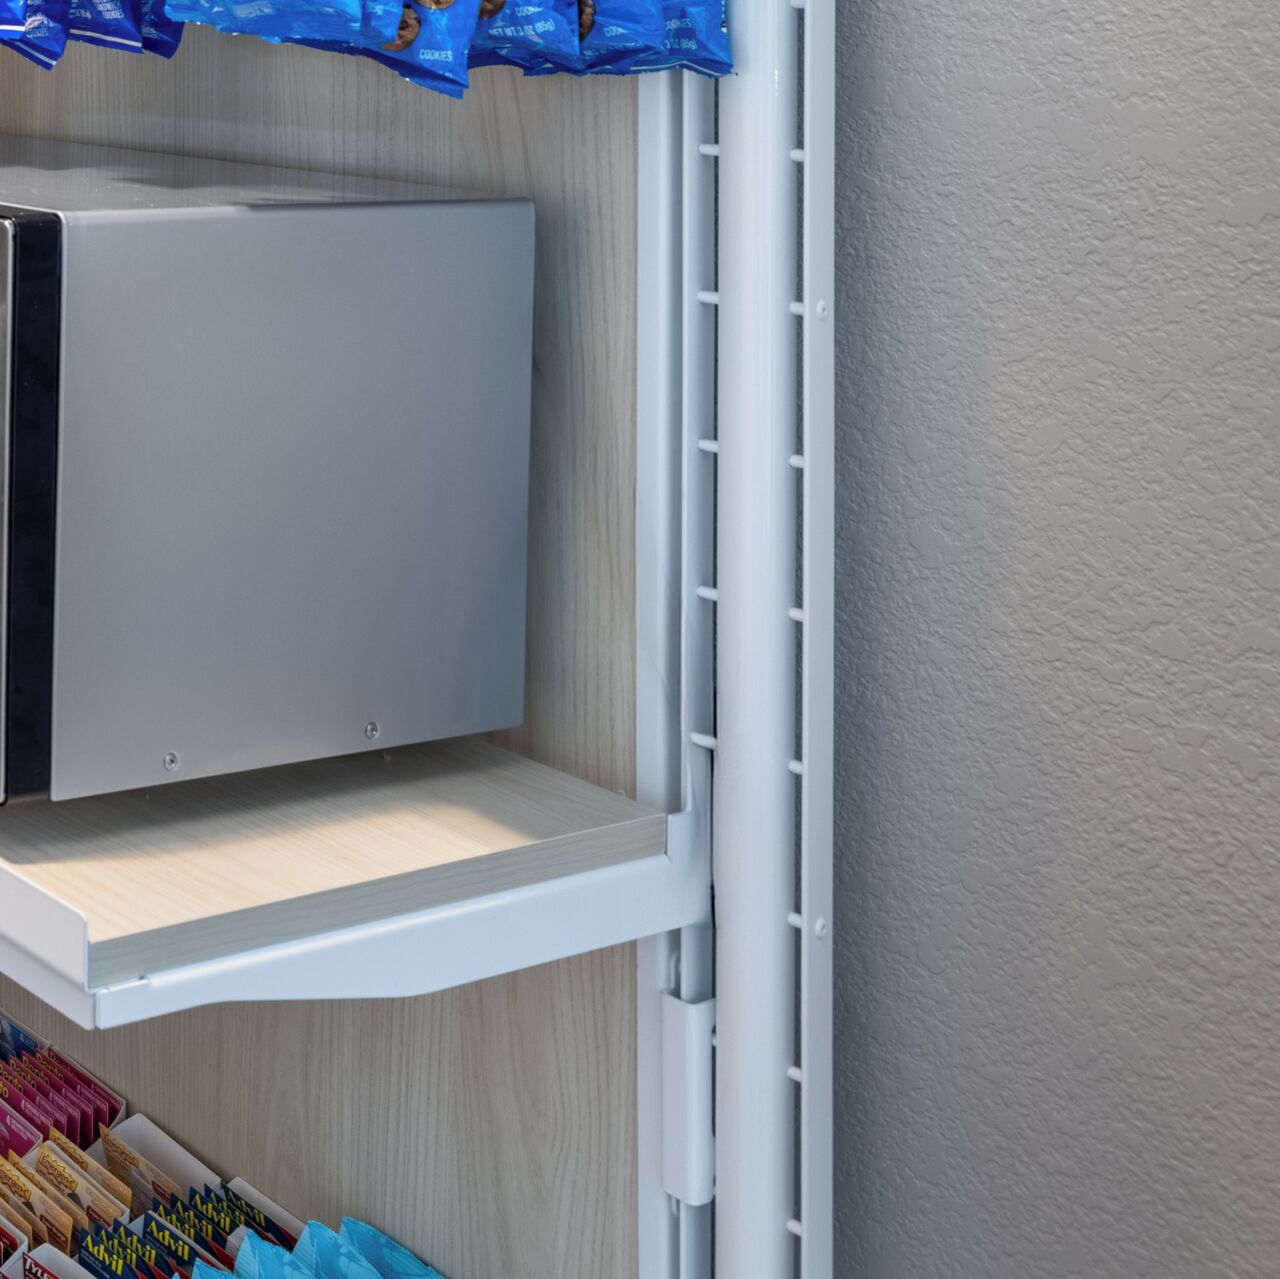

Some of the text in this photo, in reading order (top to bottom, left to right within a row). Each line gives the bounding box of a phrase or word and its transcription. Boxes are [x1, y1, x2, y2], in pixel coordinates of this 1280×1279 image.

[419, 49, 452, 62] COOKIES
[176, 1200, 213, 1241] Advil
[194, 1193, 231, 1233] Advil
[83, 1234, 123, 1276] Advil
[117, 1225, 156, 1266] Advil
[147, 1219, 189, 1261] Advil
